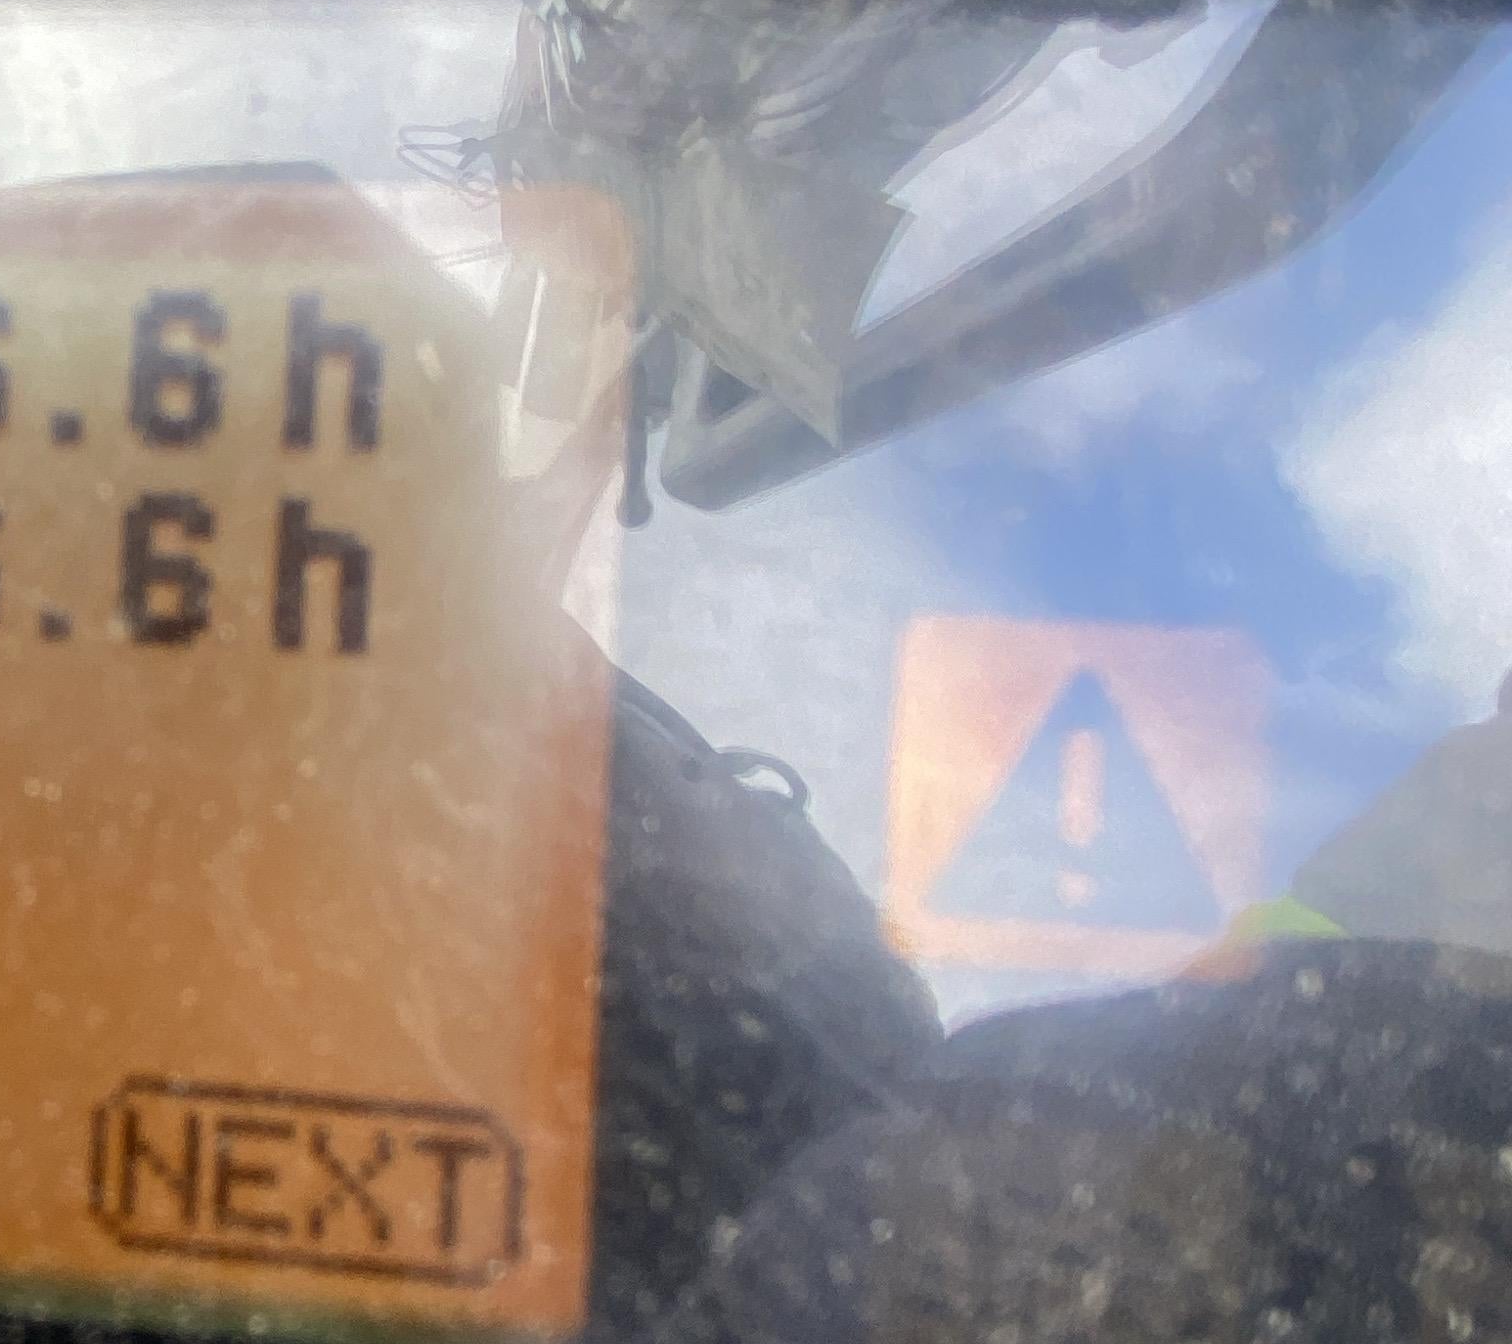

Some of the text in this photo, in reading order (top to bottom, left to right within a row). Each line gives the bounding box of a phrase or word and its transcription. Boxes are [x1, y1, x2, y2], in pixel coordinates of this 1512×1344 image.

[282, 292, 384, 452] h
[272, 496, 372, 654] h
[119, 1106, 491, 1252] NEXT
